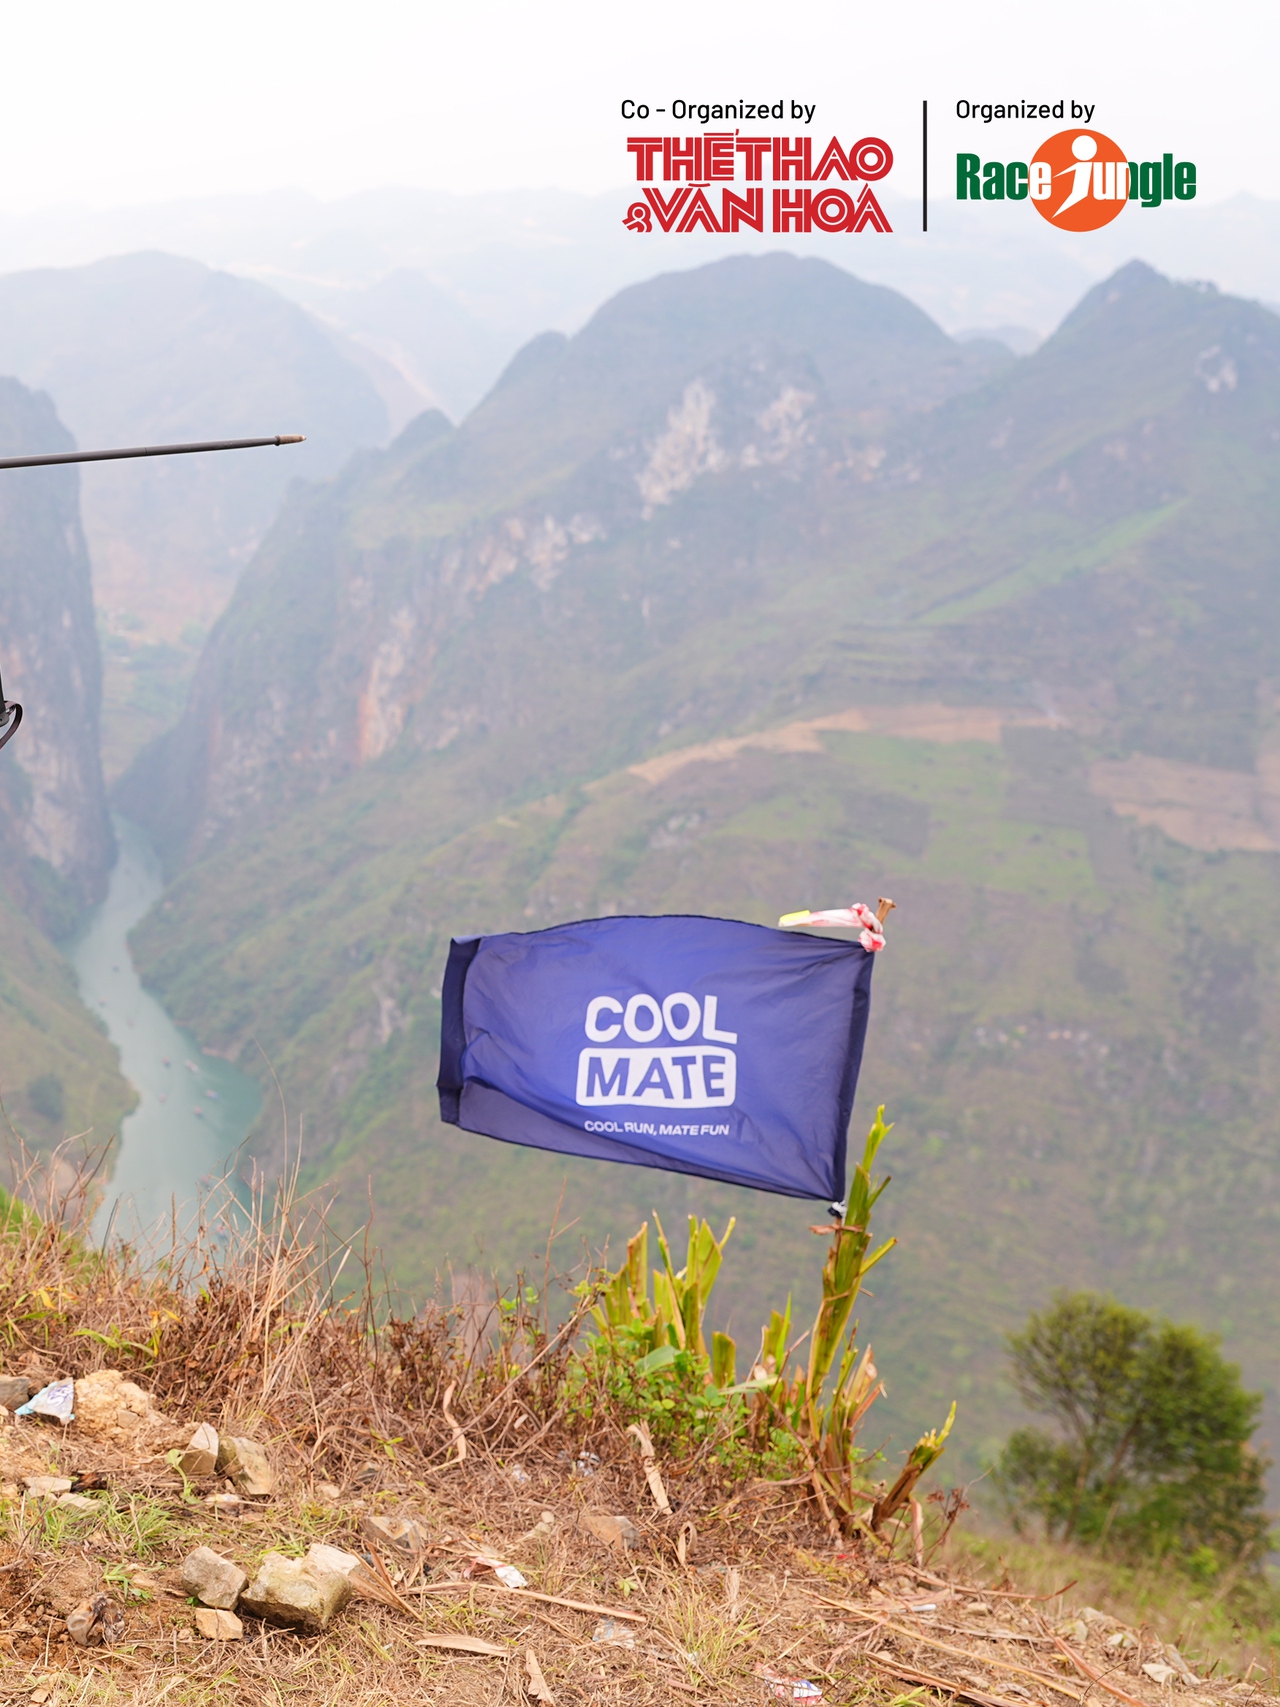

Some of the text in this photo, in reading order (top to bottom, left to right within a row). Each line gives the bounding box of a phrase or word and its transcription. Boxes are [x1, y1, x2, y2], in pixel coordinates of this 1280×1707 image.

[584, 991, 738, 1044] COOL
[585, 1055, 726, 1100] MATE
[584, 1120, 730, 1136] COOL RUN, MATE FUN
